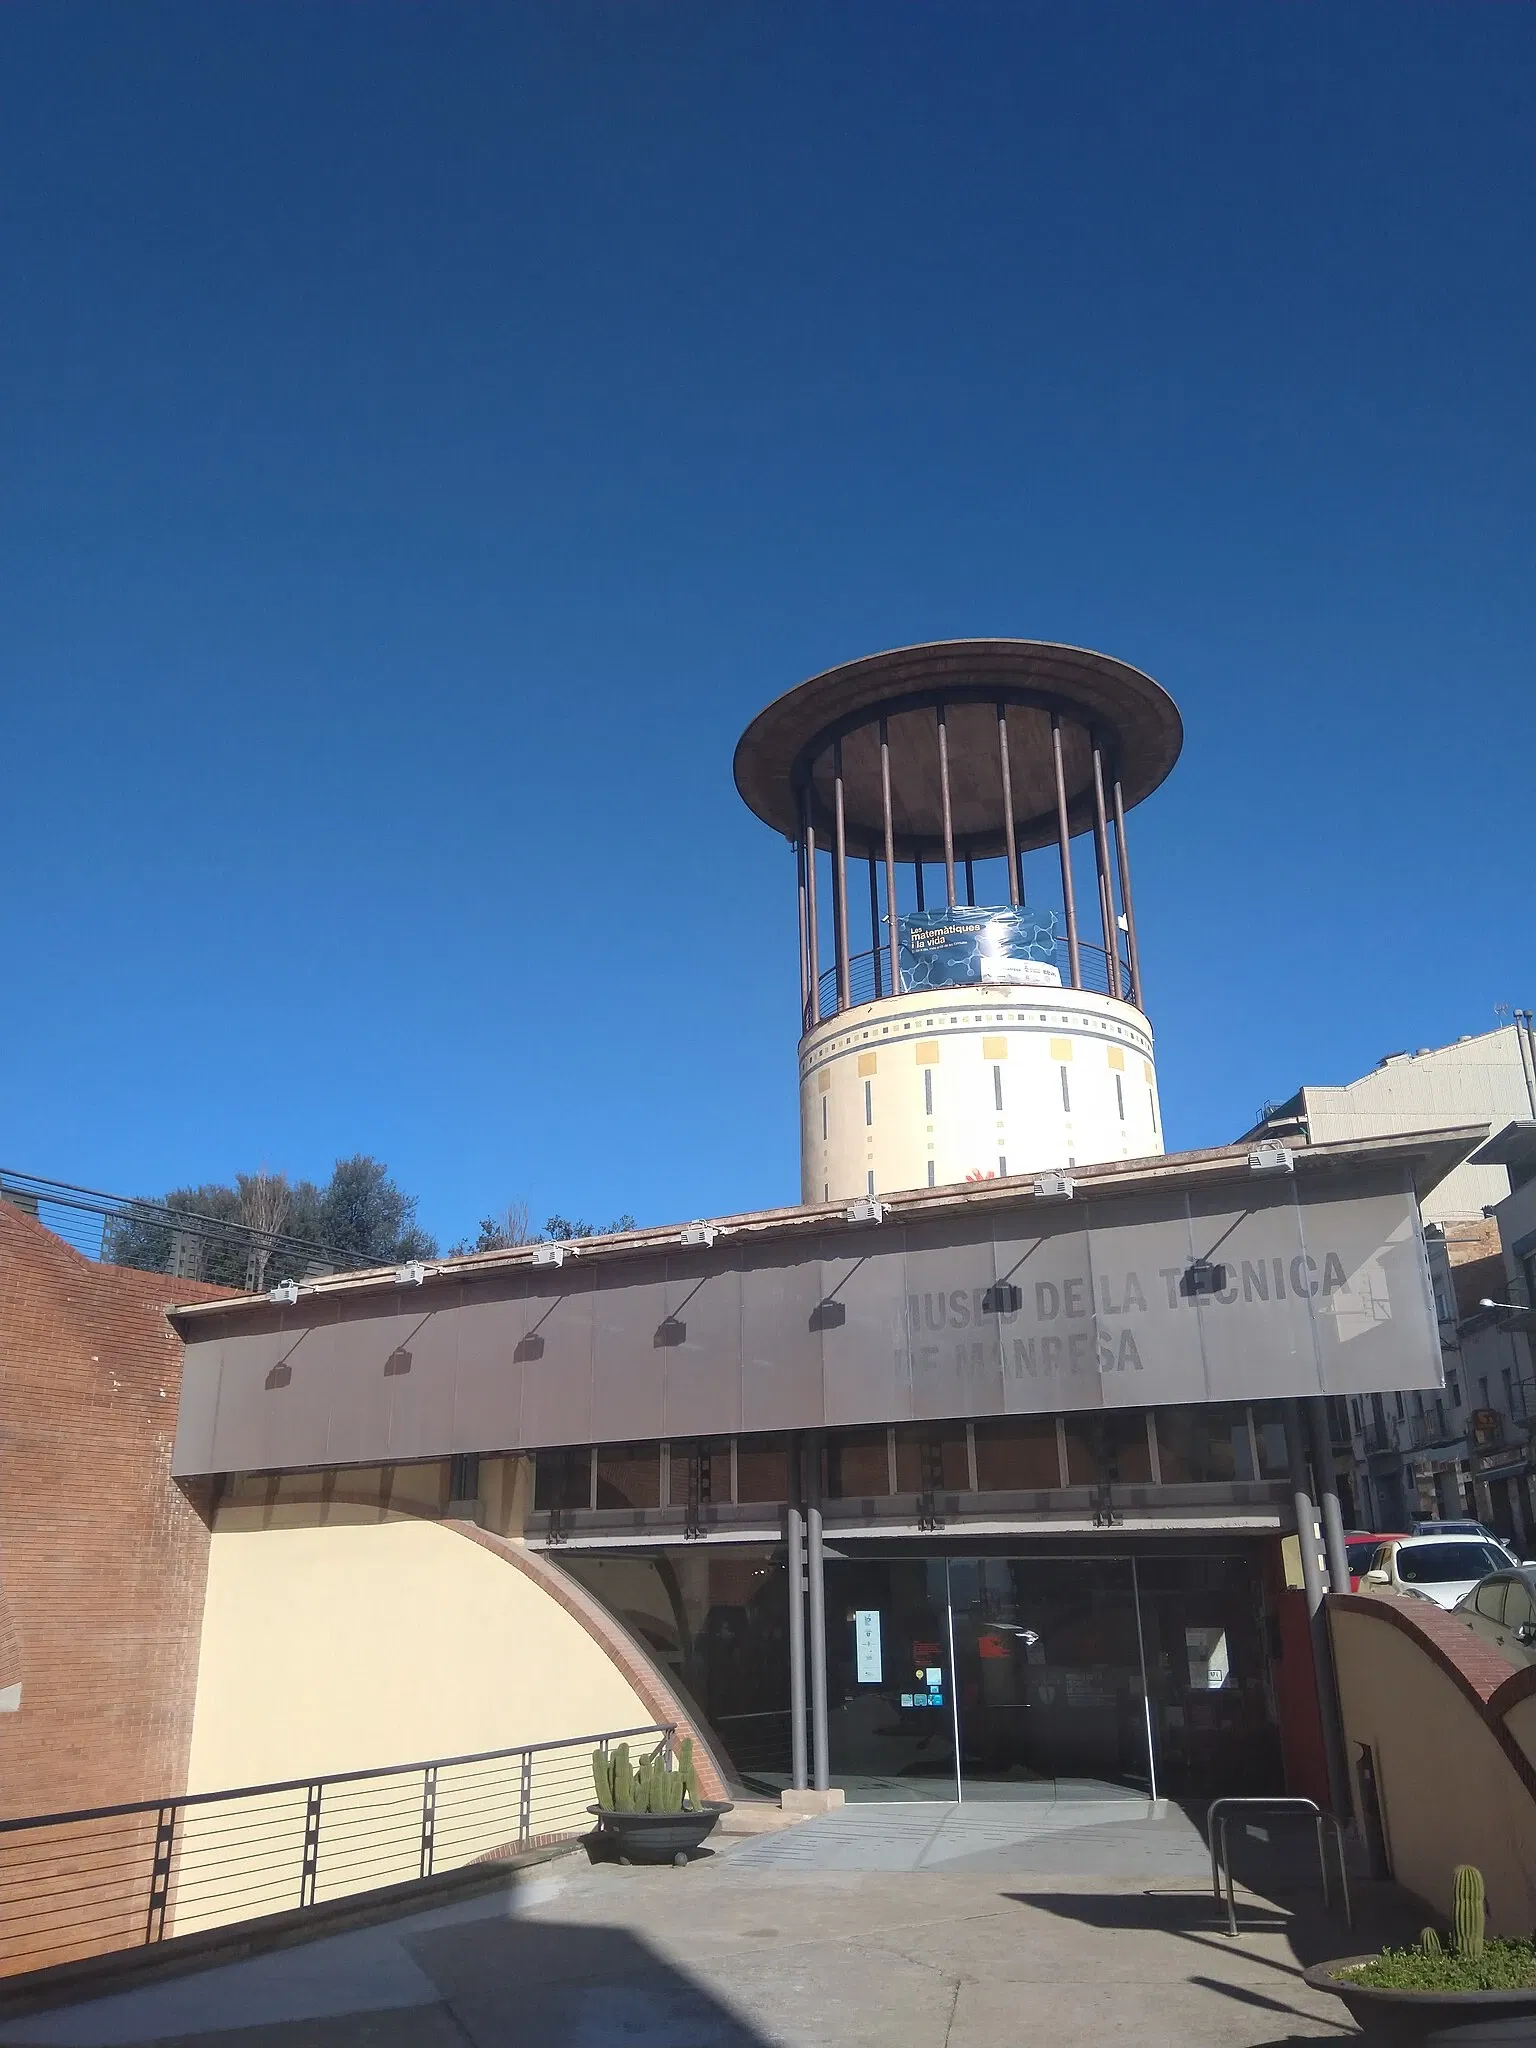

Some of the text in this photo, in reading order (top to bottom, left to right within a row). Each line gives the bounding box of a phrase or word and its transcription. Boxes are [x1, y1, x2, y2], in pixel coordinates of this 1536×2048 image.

[911, 924, 980, 941] matemàtiques
[916, 940, 925, 948] la
[927, 936, 945, 946] vida
[1034, 1278, 1087, 1321] DE
[1099, 1272, 1147, 1314] LA
